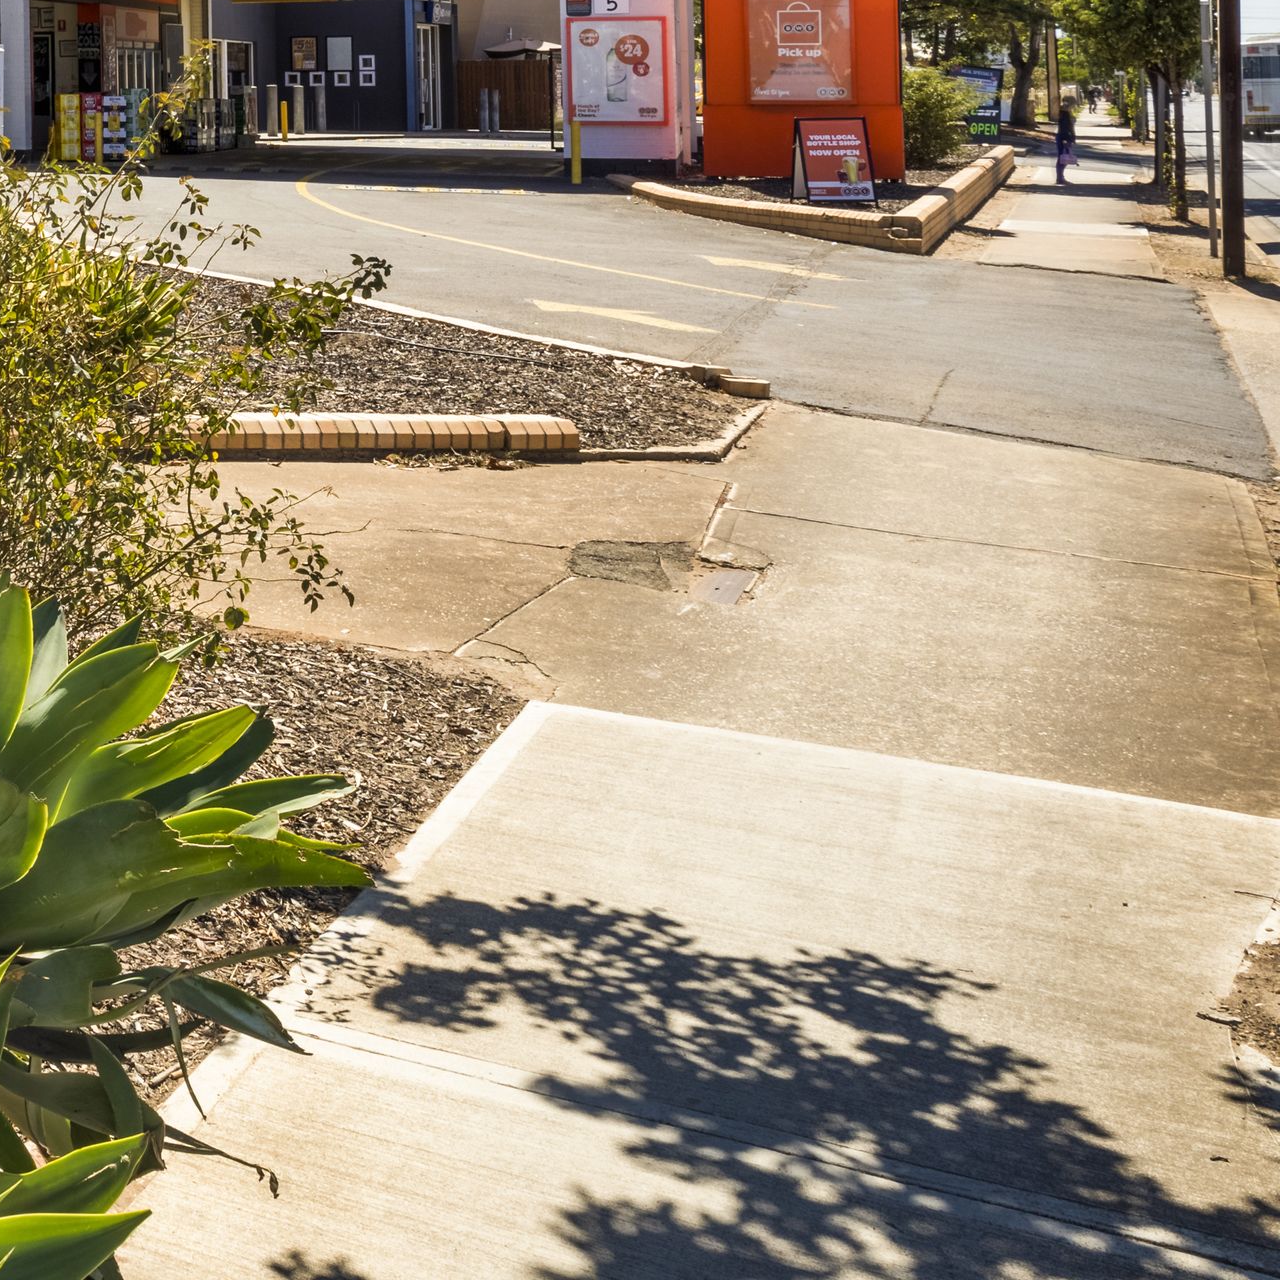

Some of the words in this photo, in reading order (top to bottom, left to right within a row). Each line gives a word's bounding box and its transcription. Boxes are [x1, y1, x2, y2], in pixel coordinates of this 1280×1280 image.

[620, 44, 642, 57] $24
[778, 48, 803, 56] Pick
[805, 49, 821, 58] up
[970, 123, 998, 135] OPEN
